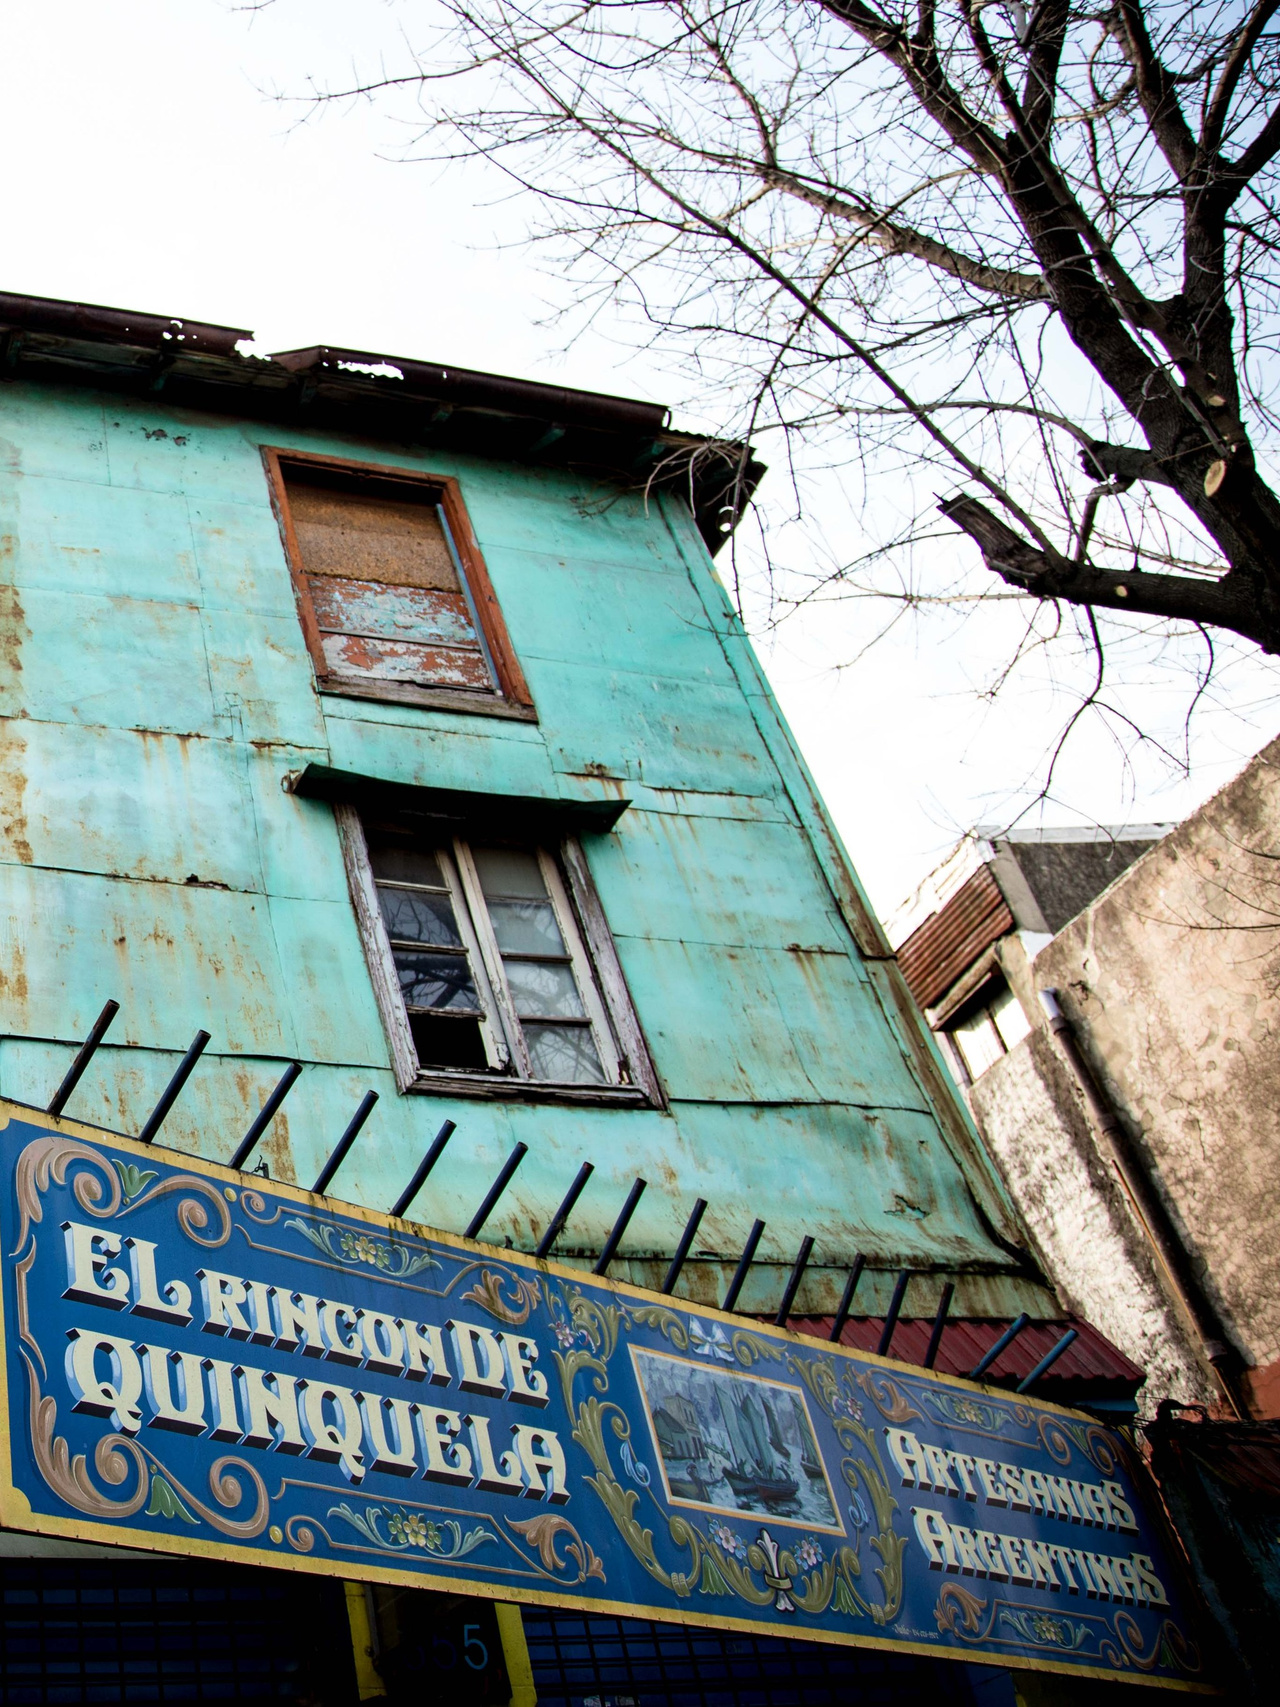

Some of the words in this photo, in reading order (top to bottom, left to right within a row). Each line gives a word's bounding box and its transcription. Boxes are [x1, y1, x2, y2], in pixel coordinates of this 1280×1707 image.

[59, 1220, 193, 1327] EL
[194, 1268, 452, 1388] RINCON
[444, 1319, 550, 1409] DE
[64, 1327, 571, 1506] QUINQUELA
[882, 1426, 1140, 1536] ARTESANIAS
[910, 1506, 1170, 1616] ARGENTINAS
